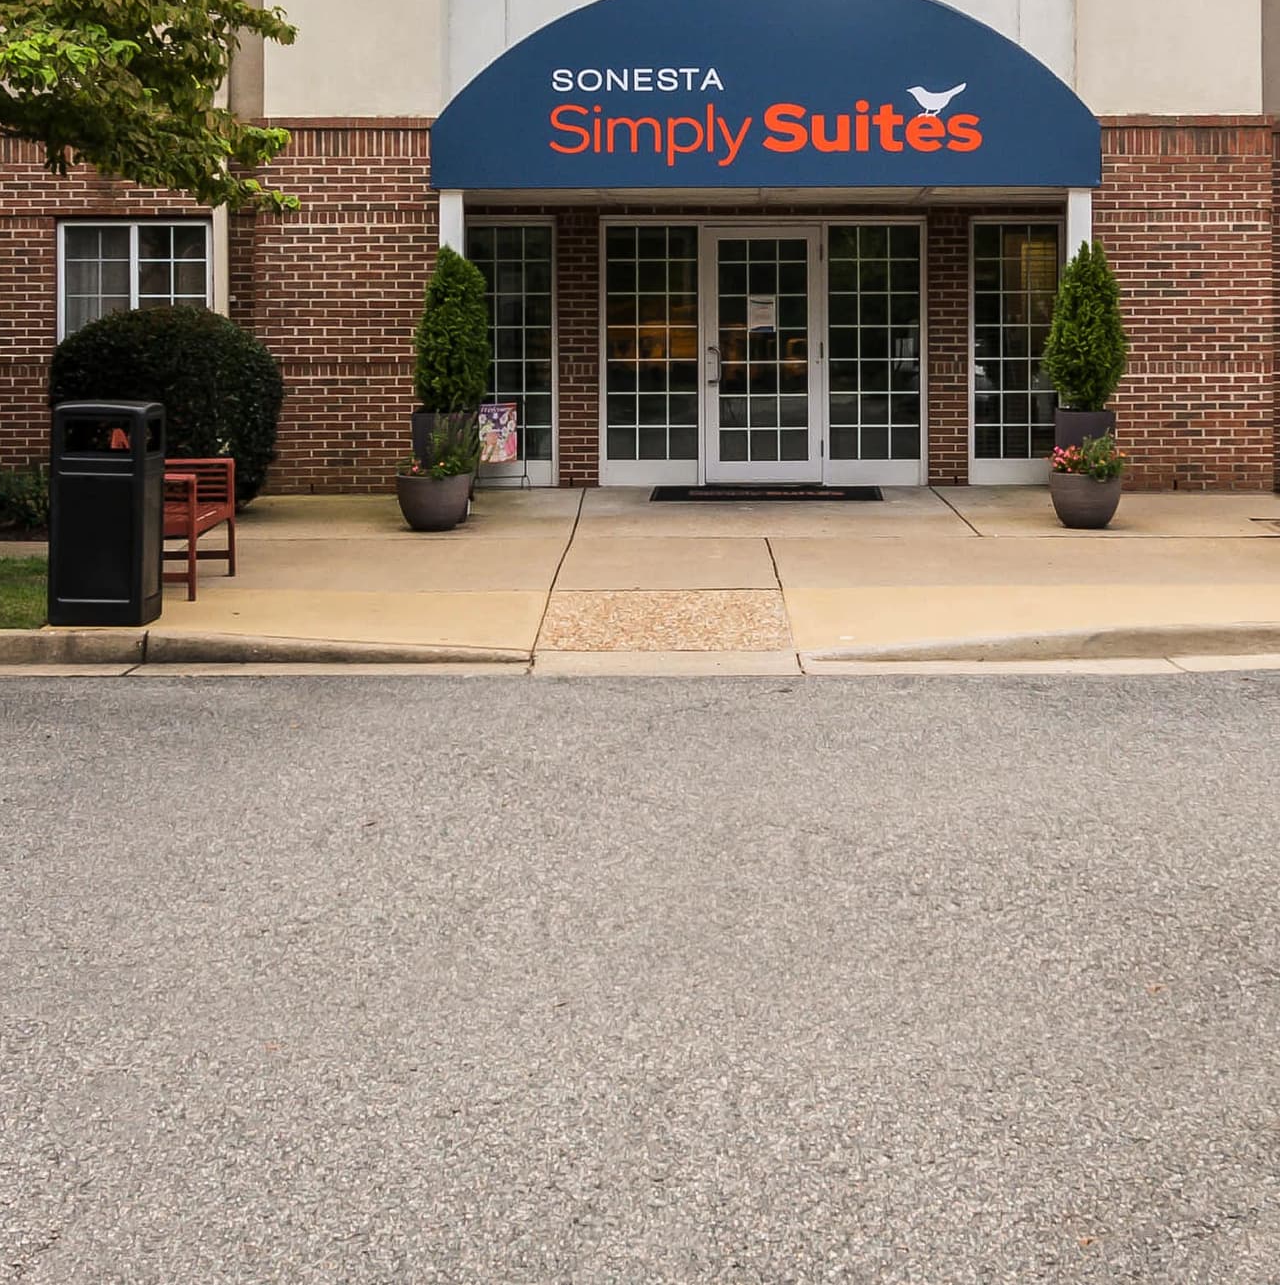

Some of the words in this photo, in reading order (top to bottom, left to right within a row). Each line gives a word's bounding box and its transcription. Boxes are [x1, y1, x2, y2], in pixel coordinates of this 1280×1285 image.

[552, 68, 724, 92] SONESTA
[549, 104, 752, 166] Simply
[763, 99, 983, 153] Suites
